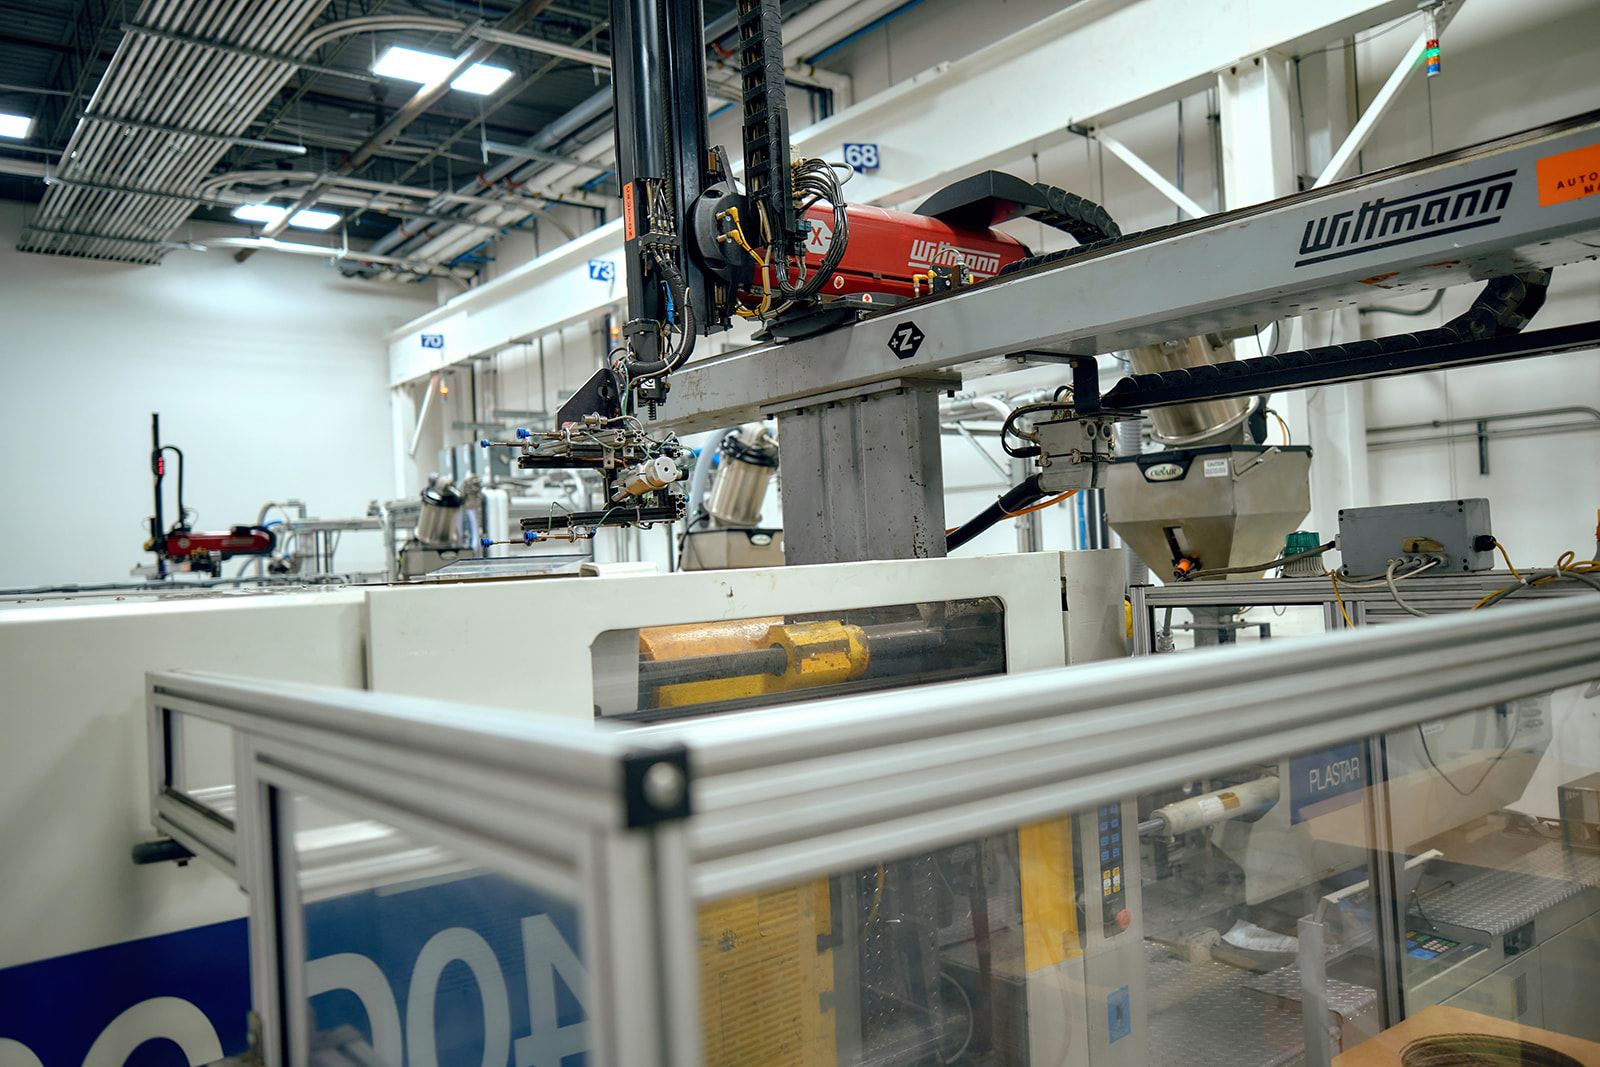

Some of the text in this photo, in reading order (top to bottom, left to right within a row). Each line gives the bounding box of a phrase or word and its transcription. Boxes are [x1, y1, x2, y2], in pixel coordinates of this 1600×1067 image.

[846, 145, 878, 167] 68
[1557, 172, 1598, 190] AUTO
[423, 336, 442, 348] 70
[1309, 757, 1360, 793] PLASTAR
